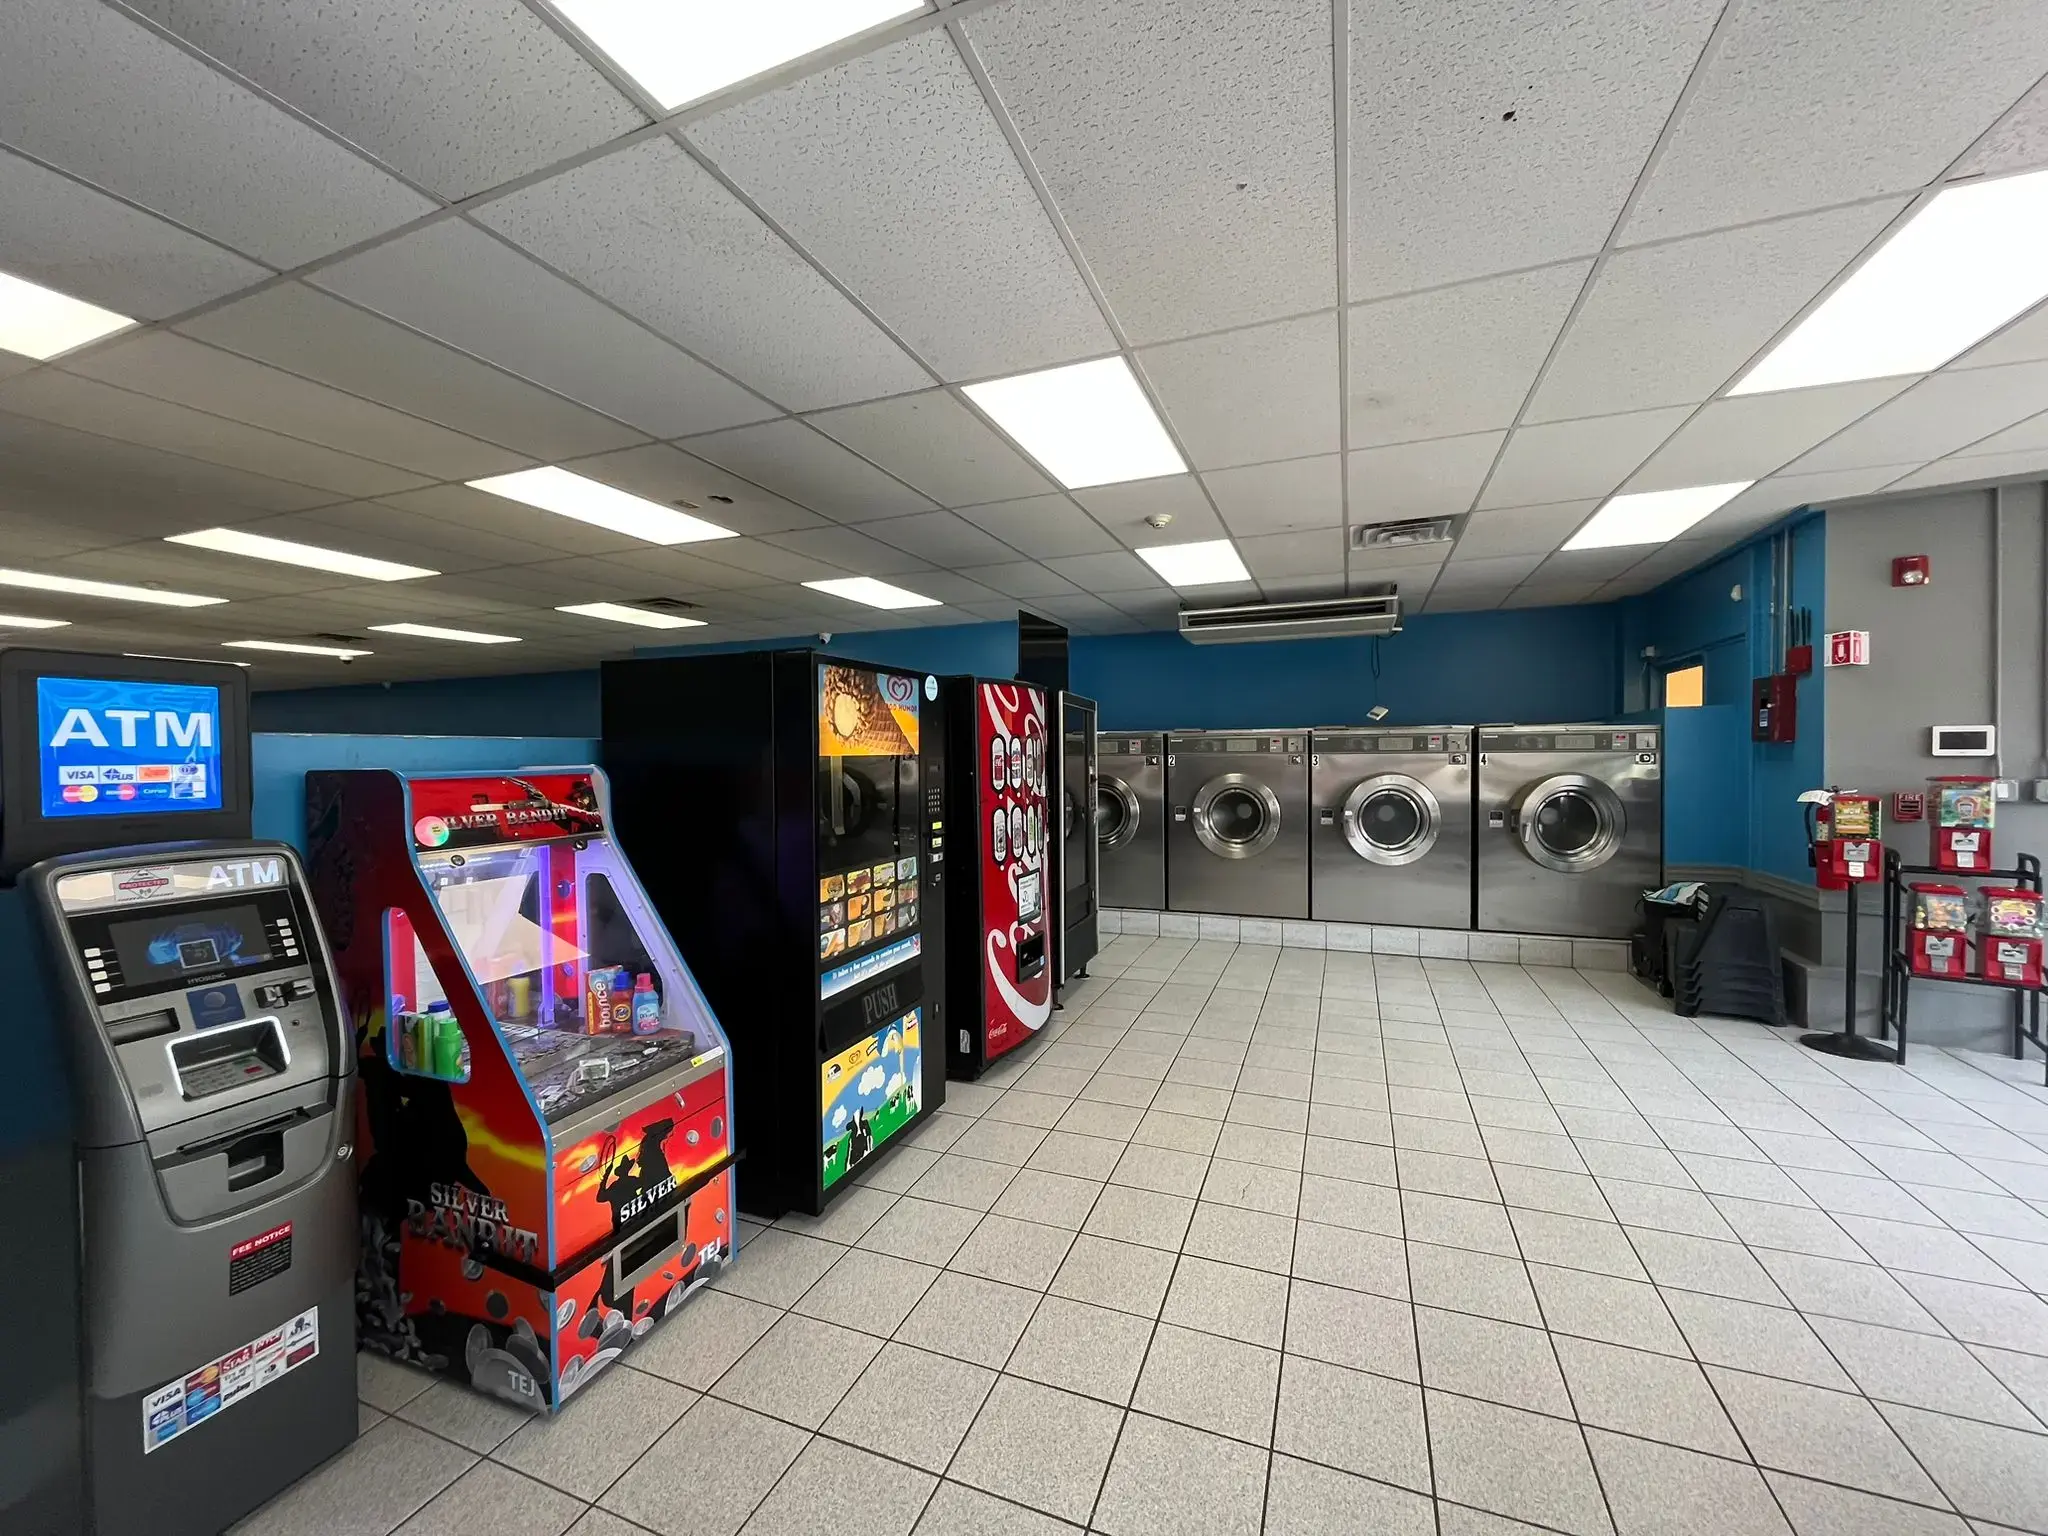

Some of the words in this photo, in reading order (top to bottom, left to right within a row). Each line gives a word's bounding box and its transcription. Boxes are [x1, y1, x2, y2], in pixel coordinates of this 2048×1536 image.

[50, 708, 212, 747] ATM
[1168, 755, 1175, 765] 2
[1312, 755, 1318, 766] 3
[1480, 754, 1487, 766] 4
[67, 770, 95, 780] VISA
[111, 772, 134, 781] PLUS
[505, 807, 569, 826] BANDIT
[119, 879, 168, 889] PROTECTED
[206, 859, 280, 890] ATM
[187, 972, 227, 985] HYOSUNG
[595, 981, 611, 1028] bounce
[863, 983, 899, 1025] PUSH
[430, 1182, 509, 1223] SILVER
[620, 1175, 678, 1223] SILVER
[232, 1242, 253, 1257] FEE
[254, 1224, 292, 1247] NOTICE
[698, 1236, 721, 1265] TEJ
[222, 1354, 251, 1373] STAR
[507, 1370, 534, 1396] TEJ
[152, 1387, 182, 1407] VISA
